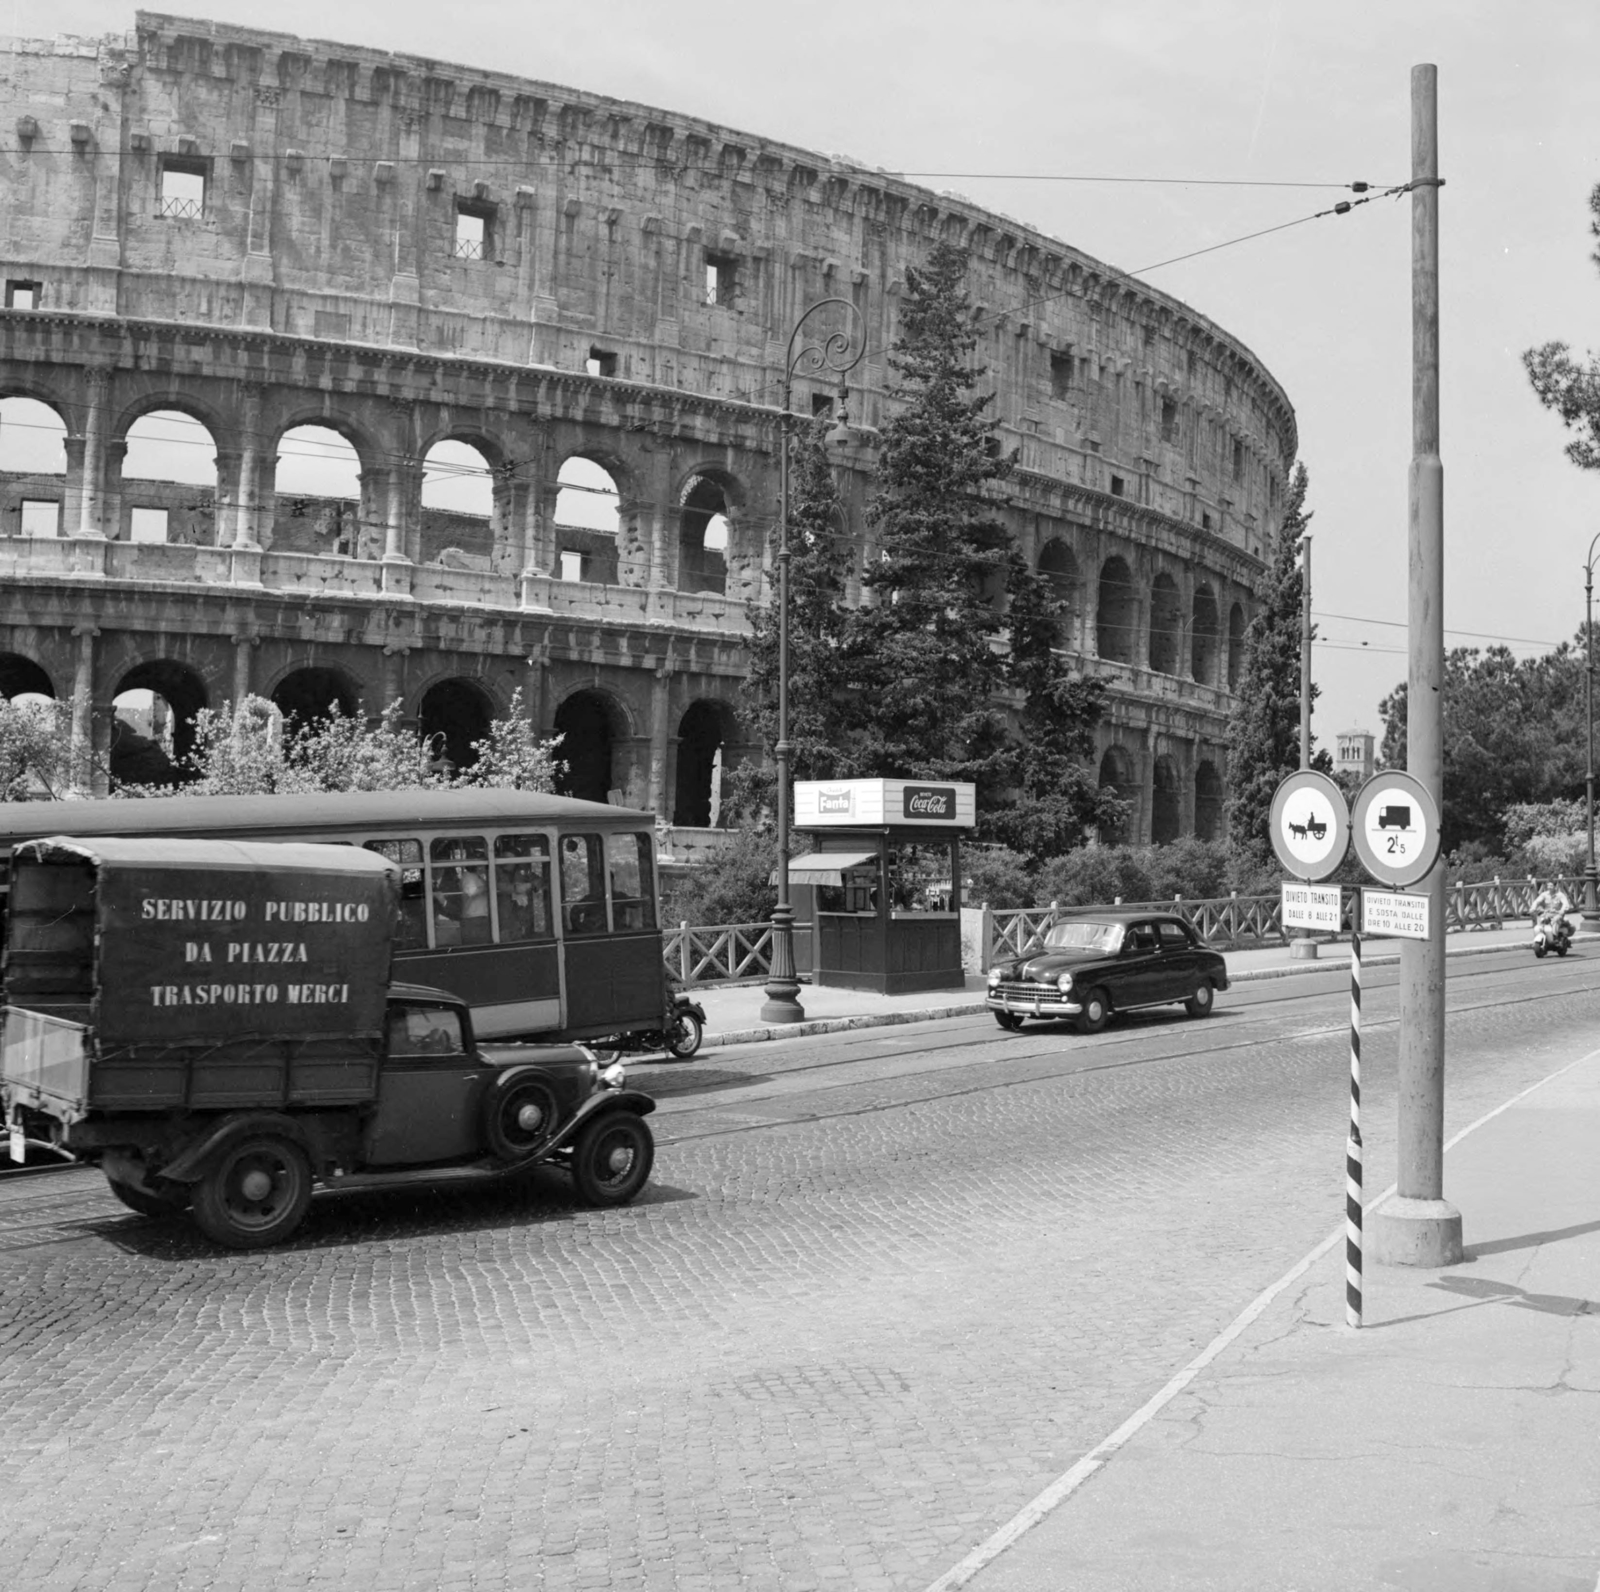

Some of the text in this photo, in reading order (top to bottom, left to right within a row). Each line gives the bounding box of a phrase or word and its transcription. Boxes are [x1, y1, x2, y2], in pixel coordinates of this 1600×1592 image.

[820, 796, 849, 811] Fanta
[909, 794, 947, 813] Coca-Cola
[1286, 890, 1338, 906] DIVIETO TRANSITO
[1366, 896, 1425, 909] DIVIETO TRANSITO
[141, 899, 369, 922] SERVIZIO PUBBLICO
[1288, 909, 1304, 919] DALLE
[1316, 911, 1328, 921] ALLE
[1376, 908, 1398, 918] SOSTA
[1402, 911, 1423, 921] DALLE
[1368, 919, 1425, 932] ORE 10 ALLE 20
[185, 942, 308, 963] DA PIAZZA
[151, 983, 349, 1006] TRASPORTO MERCI
